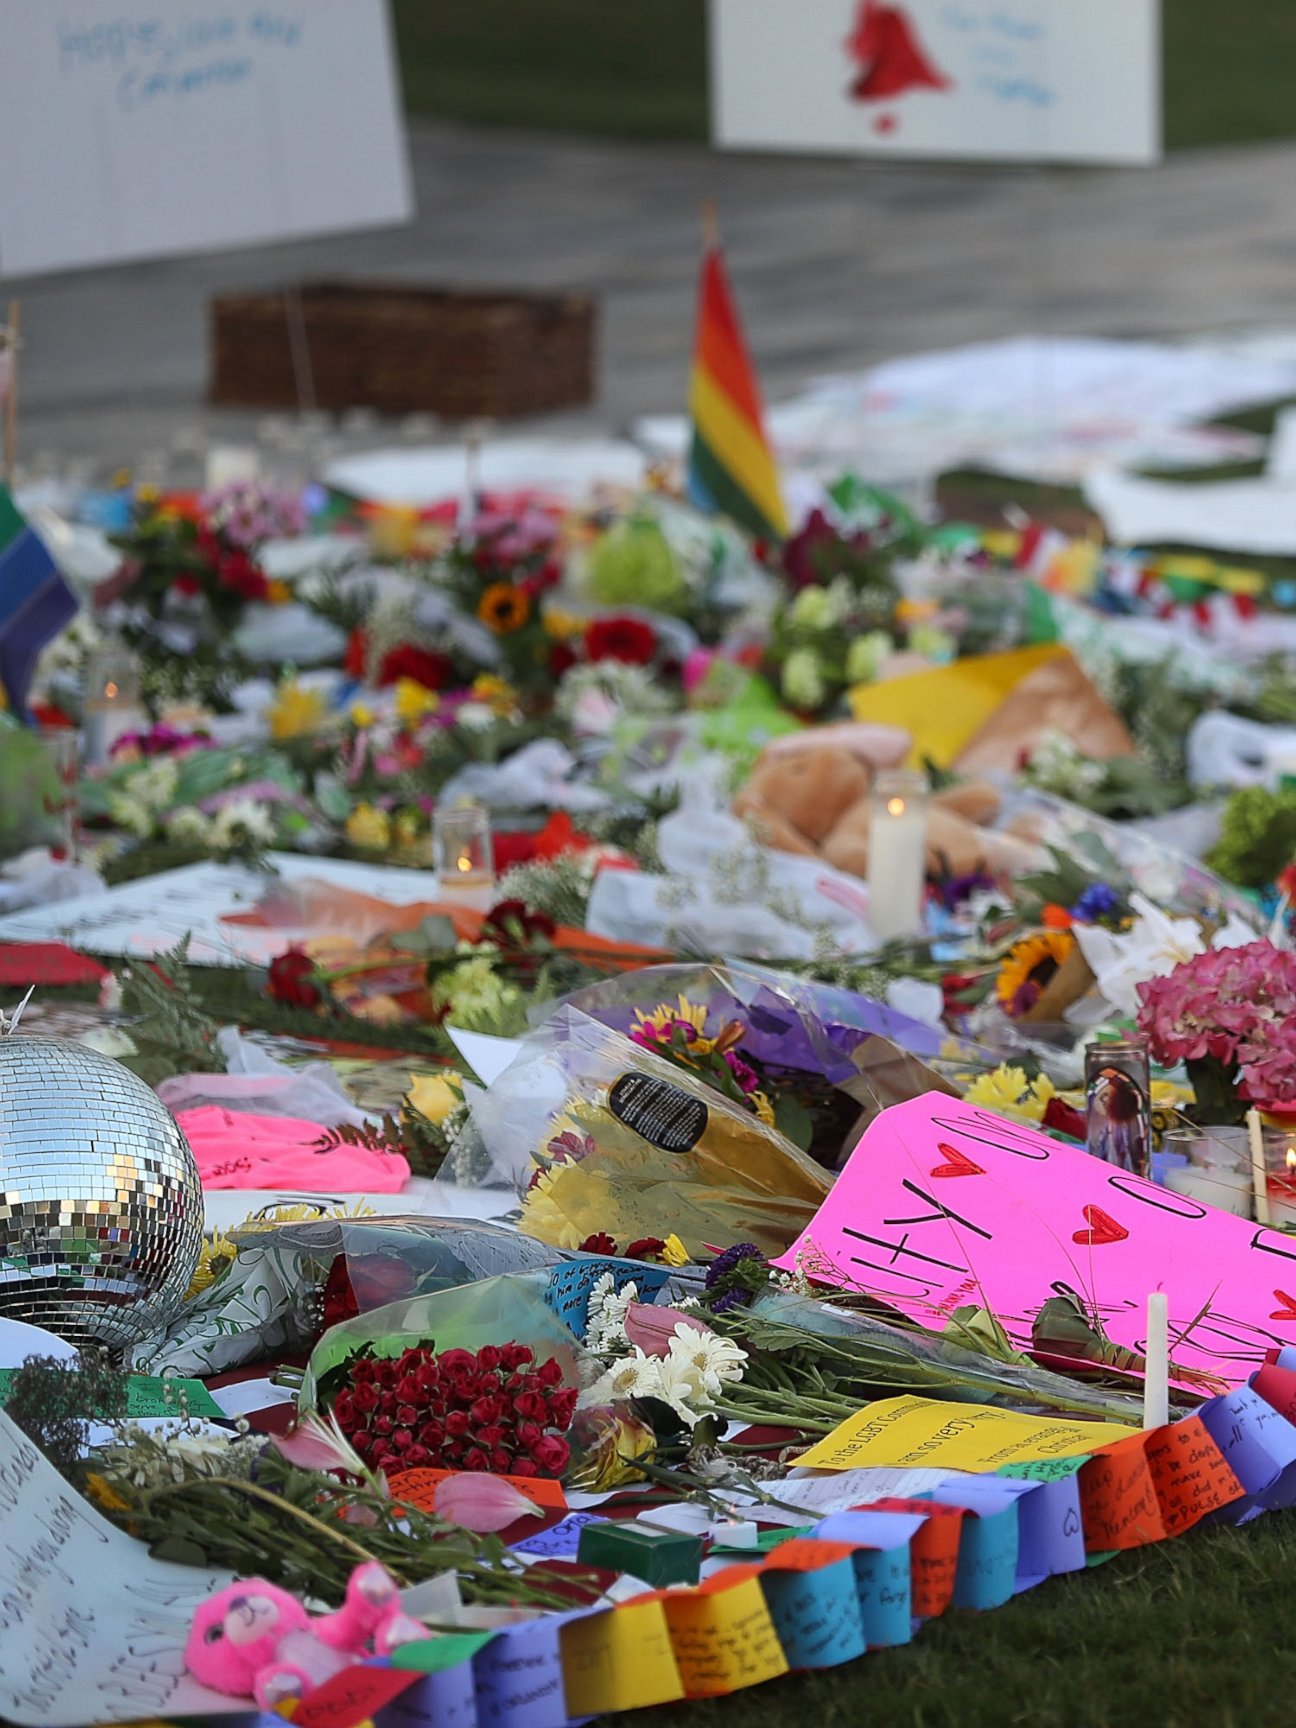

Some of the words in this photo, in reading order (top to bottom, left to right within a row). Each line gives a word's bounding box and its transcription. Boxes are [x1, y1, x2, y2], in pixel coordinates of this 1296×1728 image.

[818, 1454, 844, 1466] To
[840, 1440, 863, 1458] the
[857, 1421, 887, 1445] LGBT
[918, 1438, 943, 1455] so
[935, 1418, 976, 1443] very
